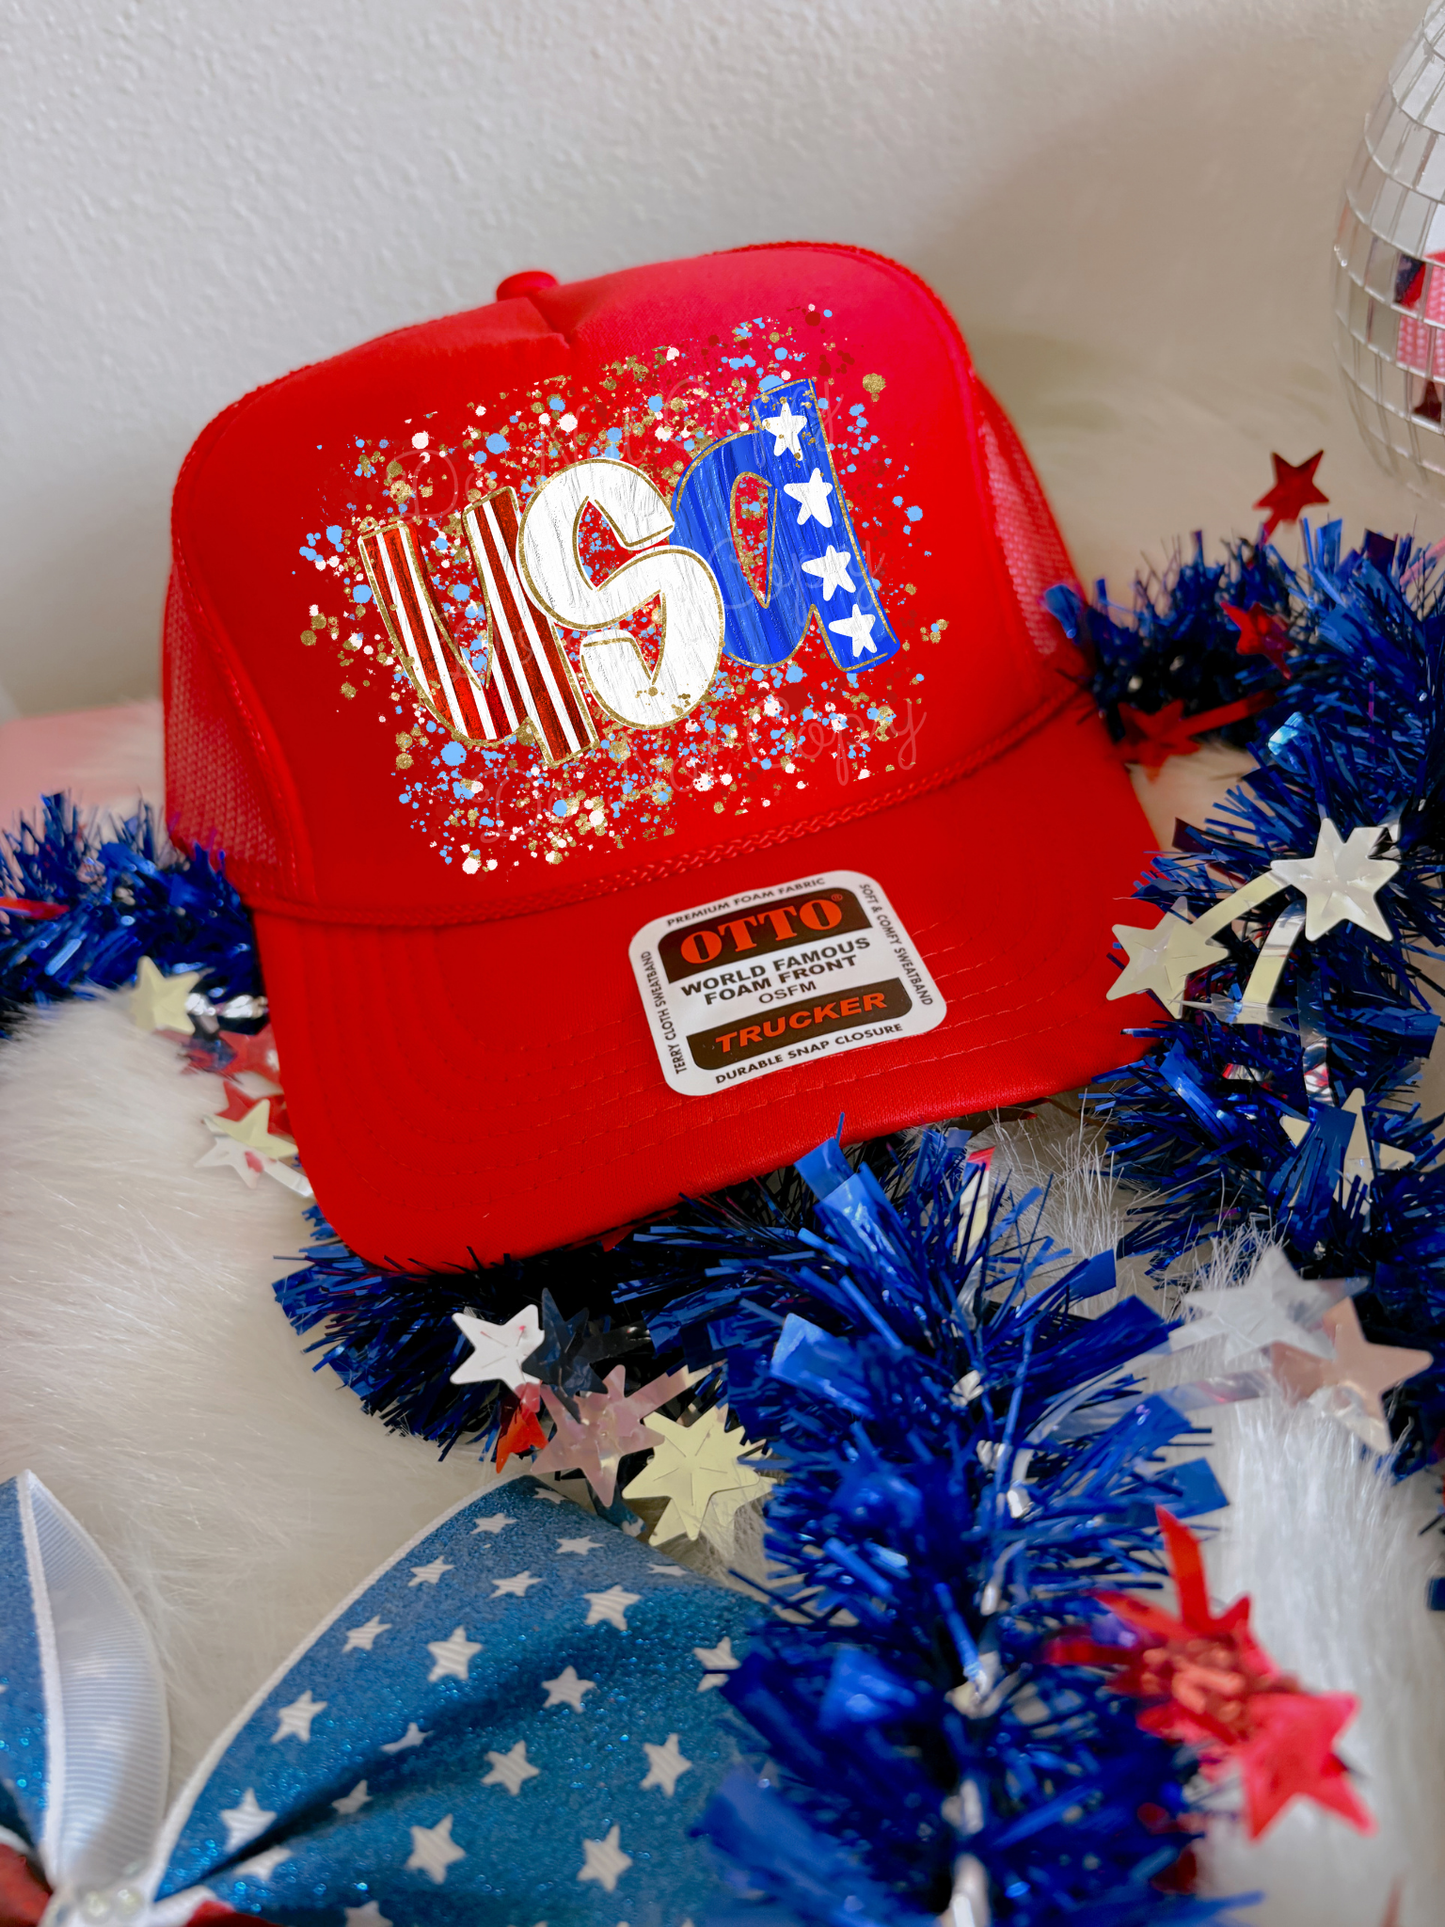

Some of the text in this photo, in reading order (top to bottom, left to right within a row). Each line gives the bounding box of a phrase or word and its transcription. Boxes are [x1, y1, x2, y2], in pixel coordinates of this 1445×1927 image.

[666, 878, 825, 926] PREMIUM FOAM FABRIC
[681, 937, 870, 996] WORLD FAMOUS
[859, 883, 933, 1006] SOFT & COMFY SWEATBAND
[704, 955, 857, 1005] FOAM FRONT
[759, 980, 817, 1004] OSFM
[641, 951, 687, 1074] TERRY CLOTH SWEATBAND
[715, 992, 888, 1053] TRUCKER
[716, 1023, 903, 1084] DURABLE SNAP CLOSURE
